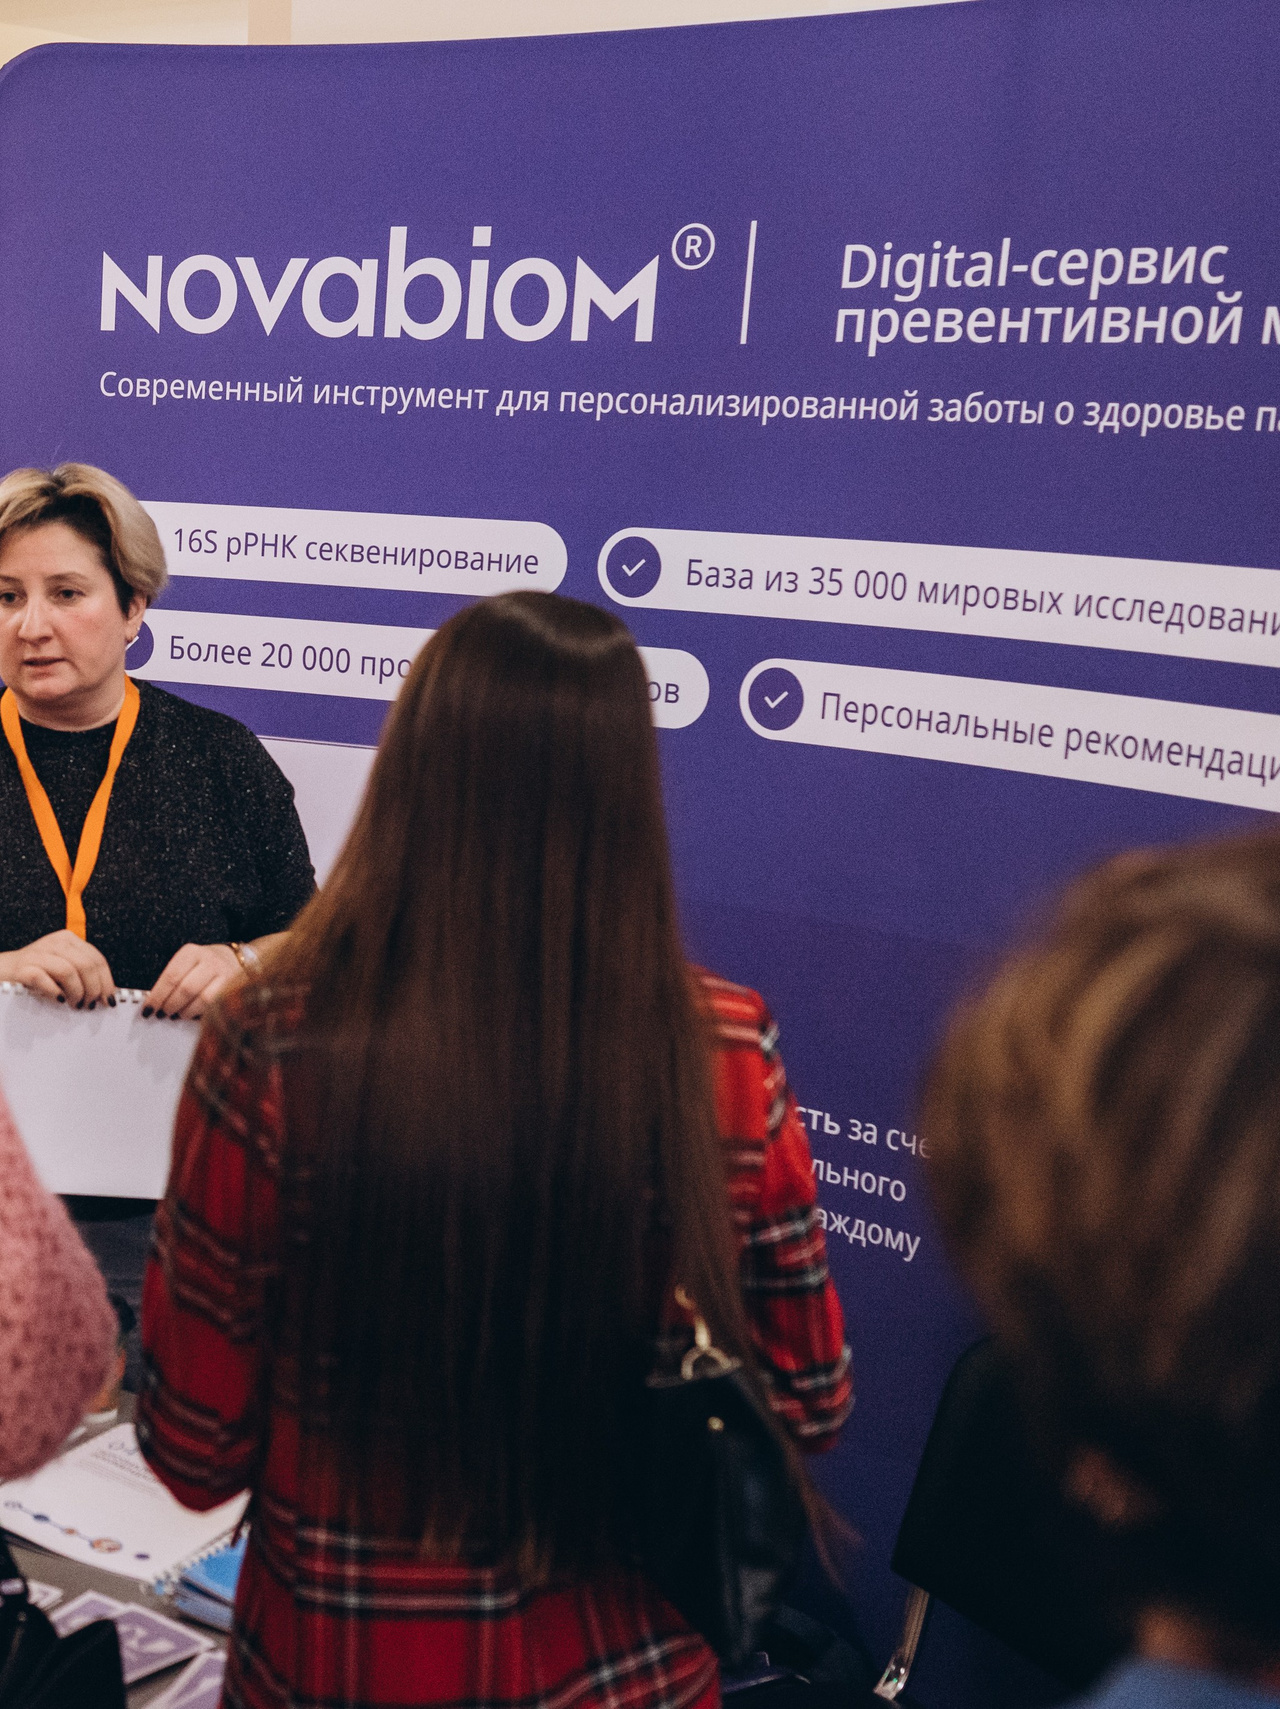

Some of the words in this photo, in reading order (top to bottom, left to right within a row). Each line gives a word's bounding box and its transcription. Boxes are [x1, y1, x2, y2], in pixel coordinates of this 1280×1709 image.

[841, 237, 1229, 302] Digital-сервис
[835, 289, 1243, 357] превентивной
[99, 370, 304, 406] Современный
[313, 383, 490, 415] инструмент
[495, 389, 550, 417] для
[559, 389, 919, 426] персонализированной
[927, 390, 1045, 425] заботы
[1054, 399, 1075, 426] о
[1082, 401, 1246, 438] здоровье
[174, 527, 218, 555] 16S
[225, 531, 298, 563] рРНК
[304, 541, 540, 576] секвенирование
[686, 558, 754, 591] База
[764, 570, 799, 594] из
[808, 565, 844, 597] 35
[853, 568, 908, 602] 000
[917, 580, 1064, 616] мировых
[169, 634, 252, 666] Более
[260, 641, 293, 670] 20
[301, 644, 351, 674] 000
[819, 691, 1055, 748] Персональные
[847, 1118, 878, 1145] за
